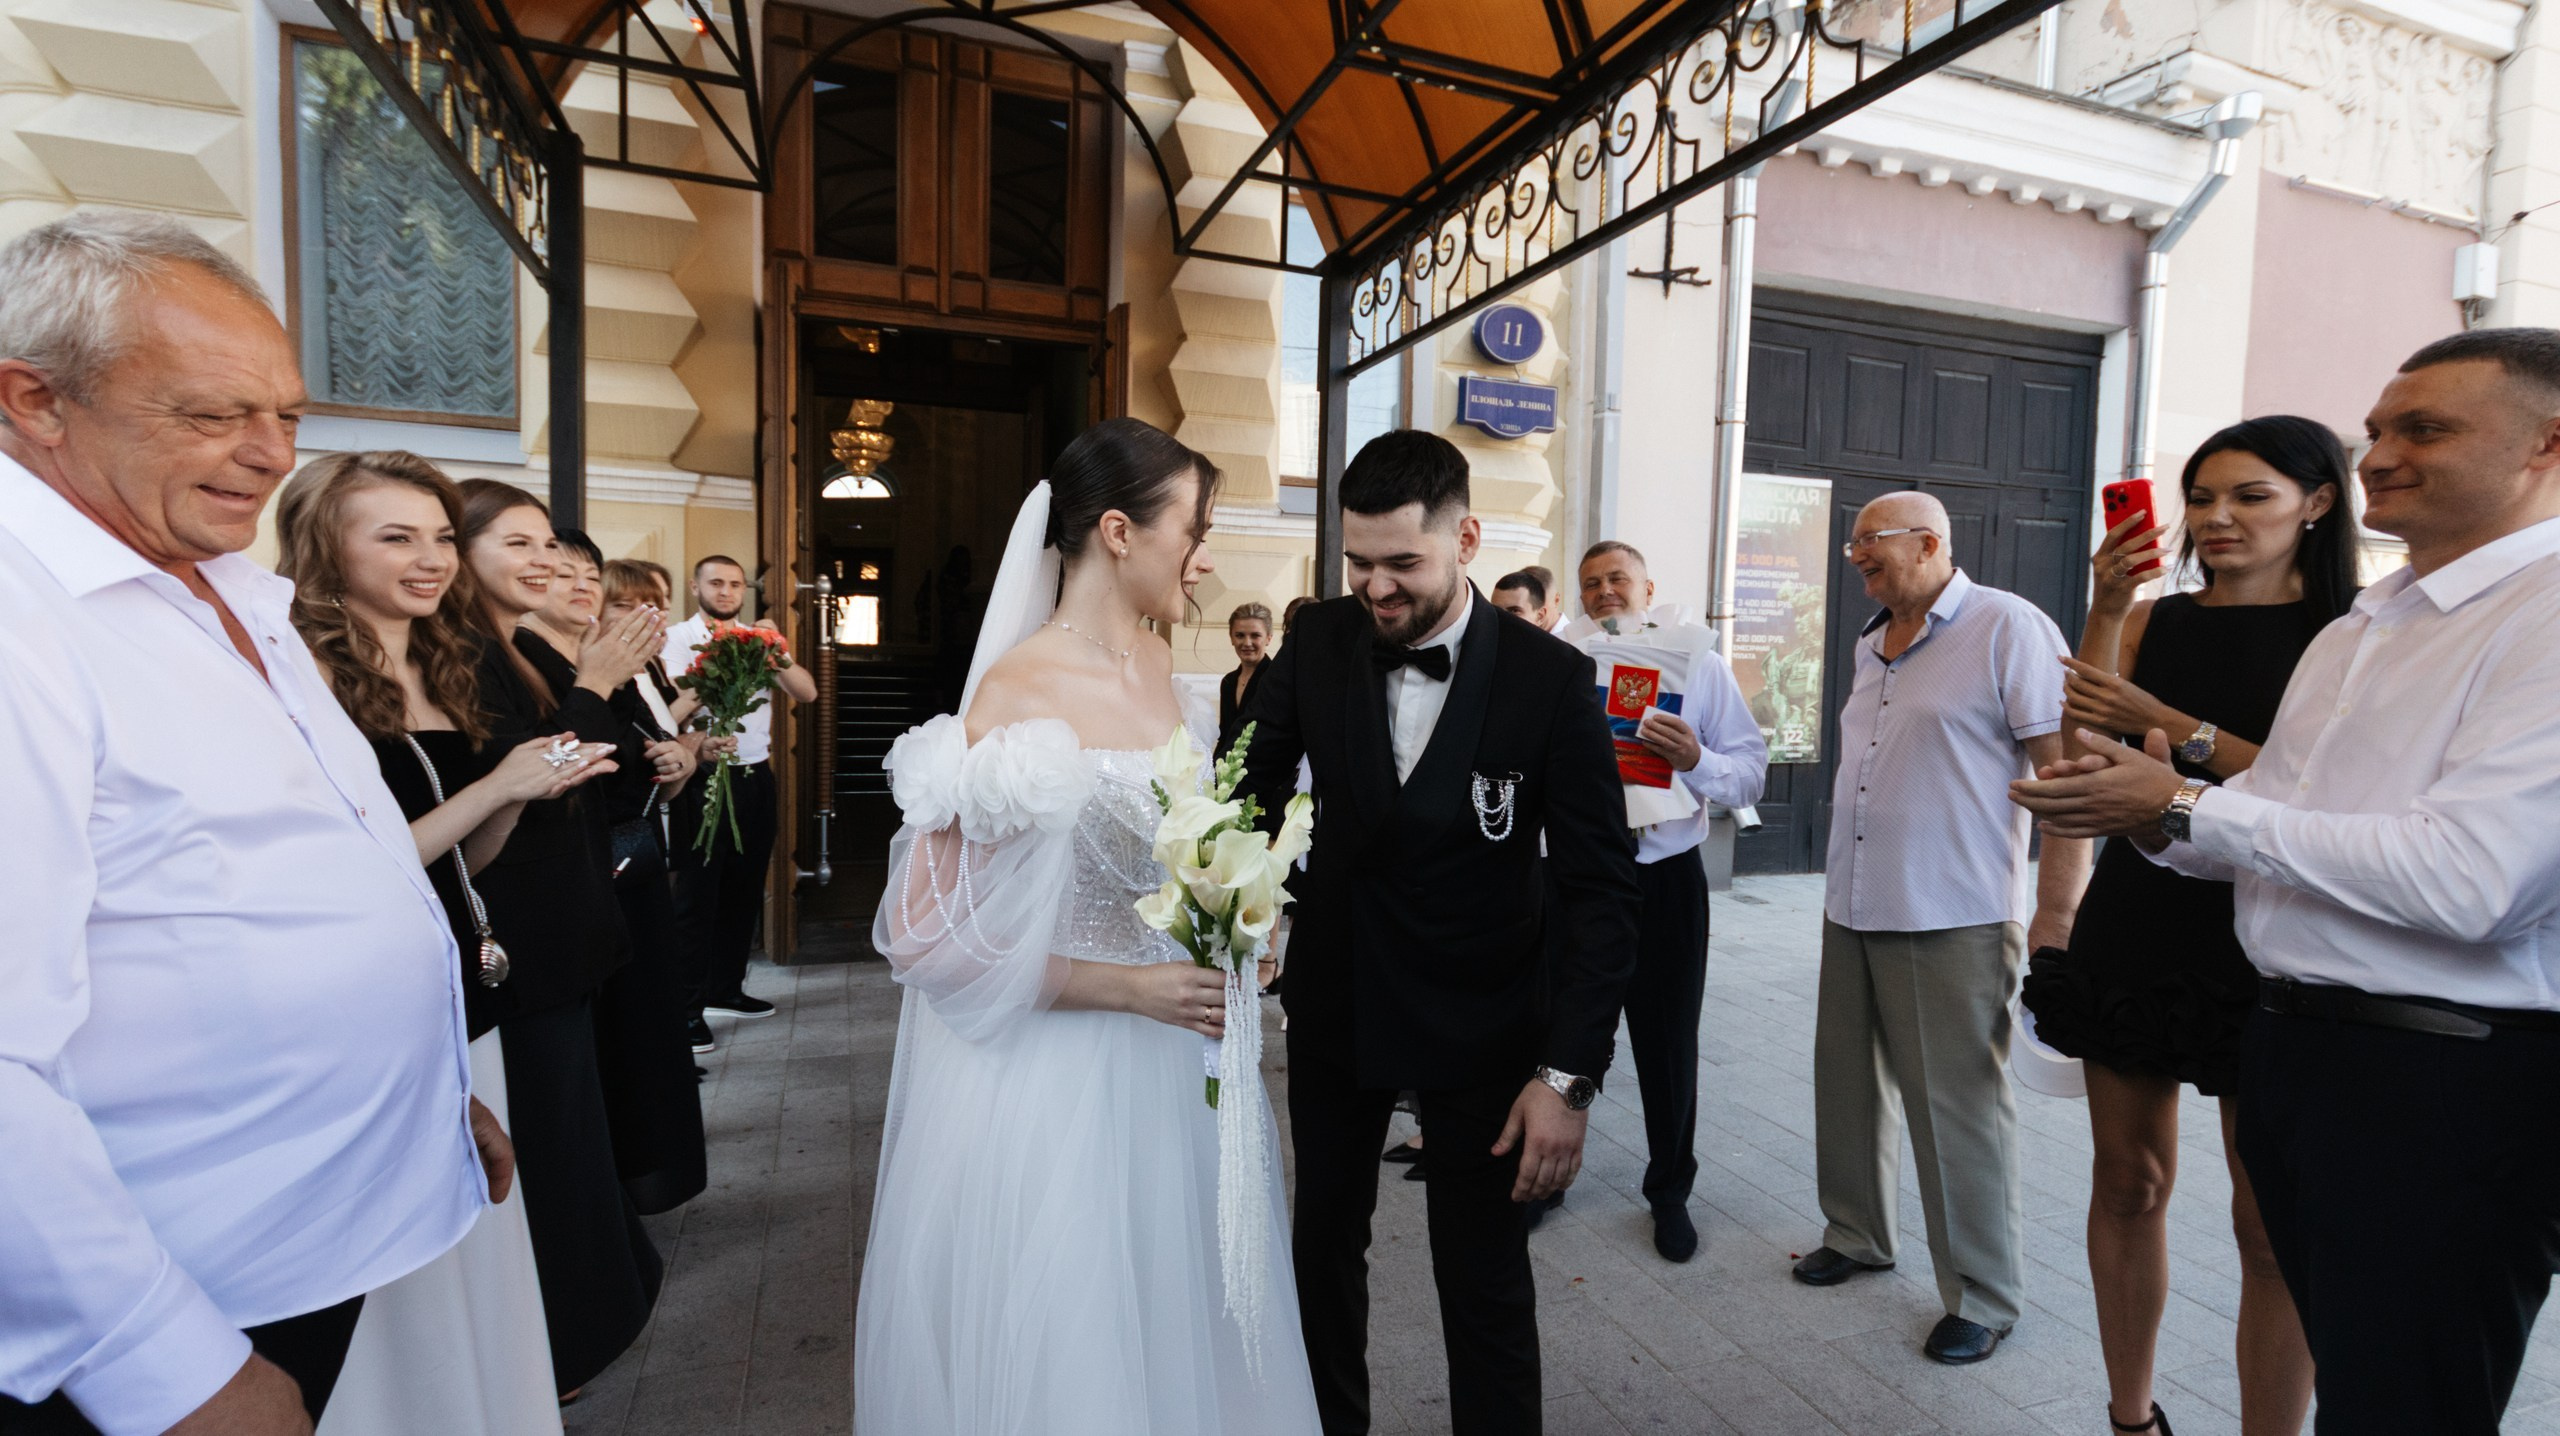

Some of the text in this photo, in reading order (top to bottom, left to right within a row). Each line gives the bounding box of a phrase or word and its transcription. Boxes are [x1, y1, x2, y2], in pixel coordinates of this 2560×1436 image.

[1502, 321, 1523, 346] 11
[1471, 394, 1552, 412] ПЛОЩАДЬ ЛЕНИНА
[1740, 502, 1802, 525] АБОТА
